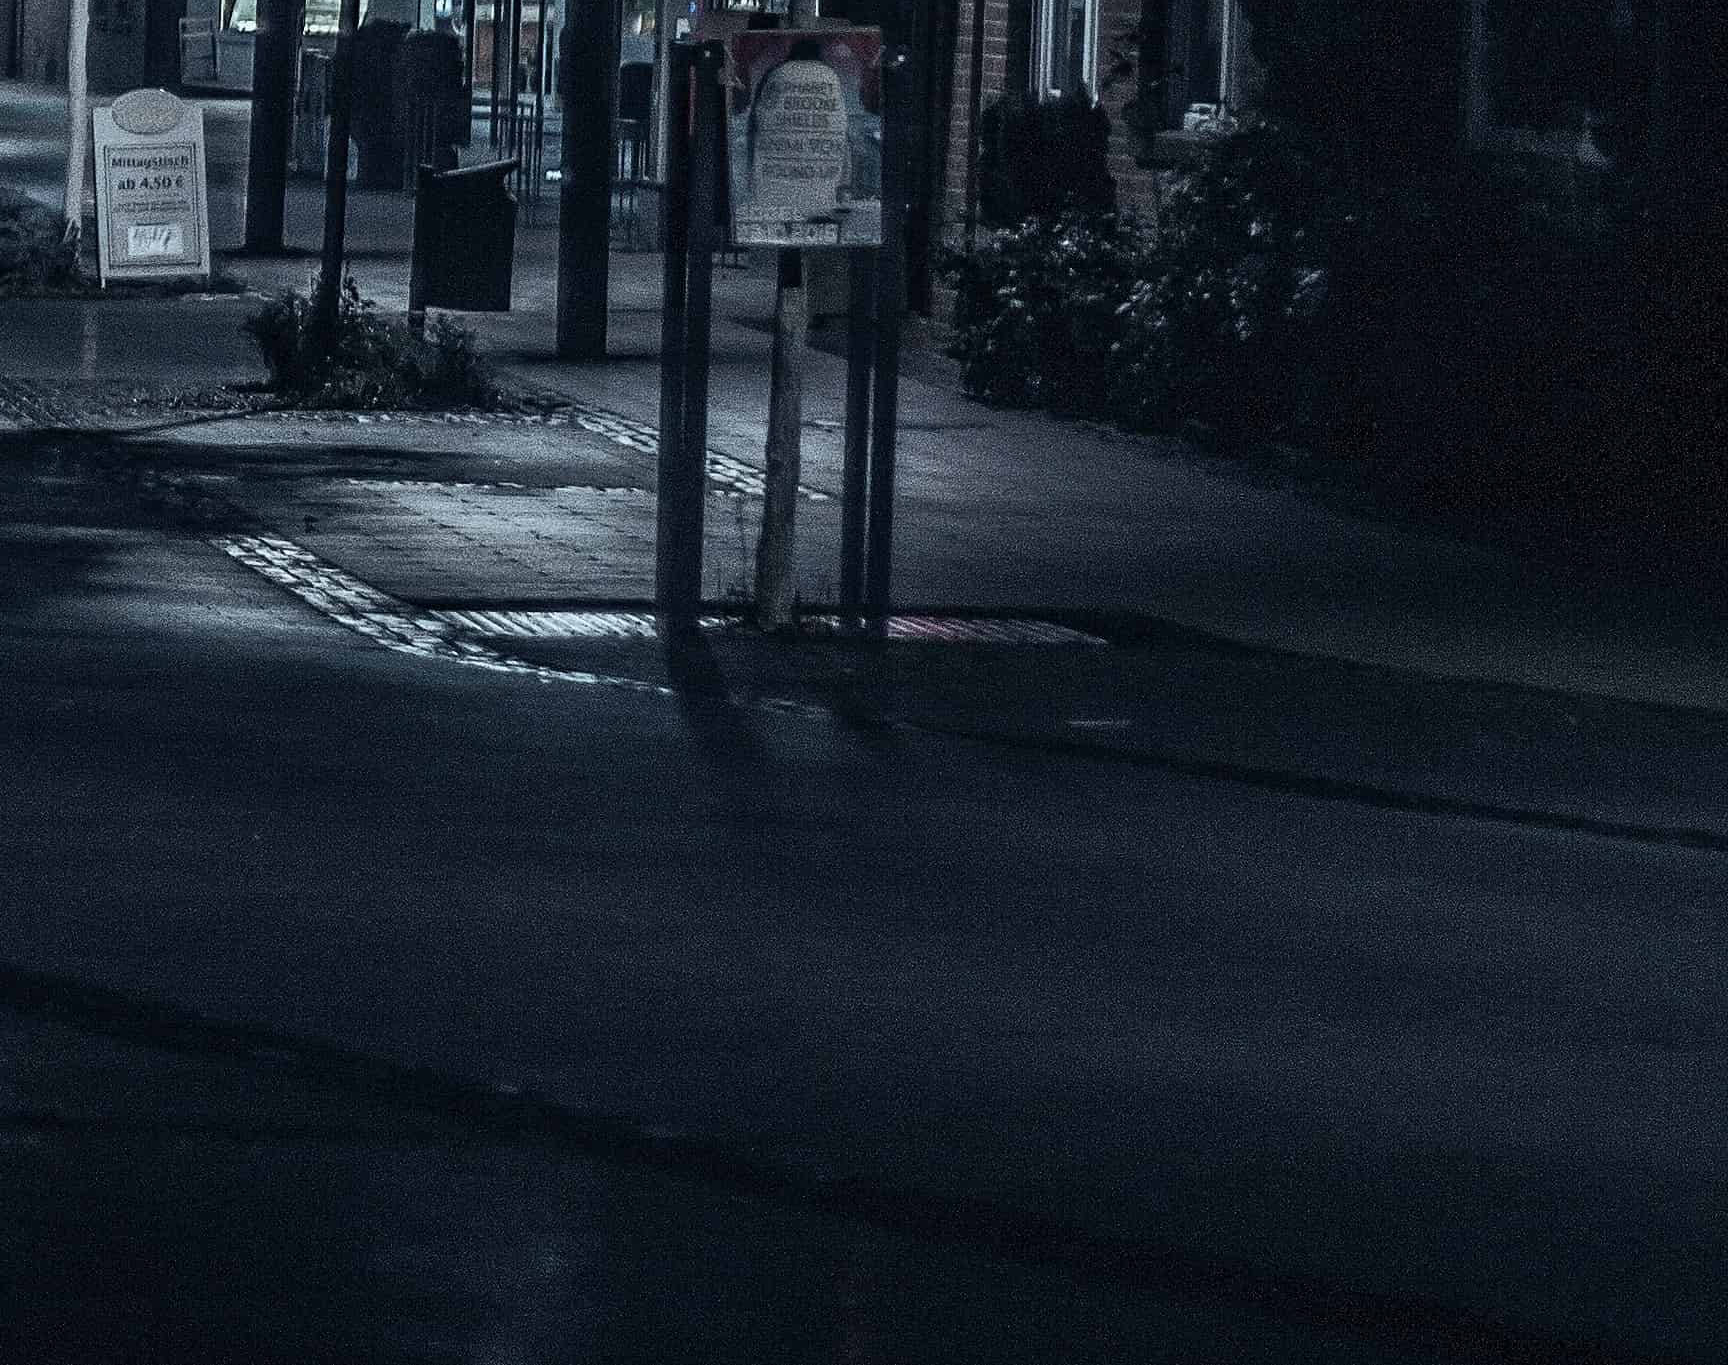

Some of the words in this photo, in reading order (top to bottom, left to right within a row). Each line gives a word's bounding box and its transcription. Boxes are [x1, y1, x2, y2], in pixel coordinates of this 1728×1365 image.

[112, 155, 189, 170] Mittagstisch
[118, 177, 135, 190] ab
[176, 175, 184, 188] €
